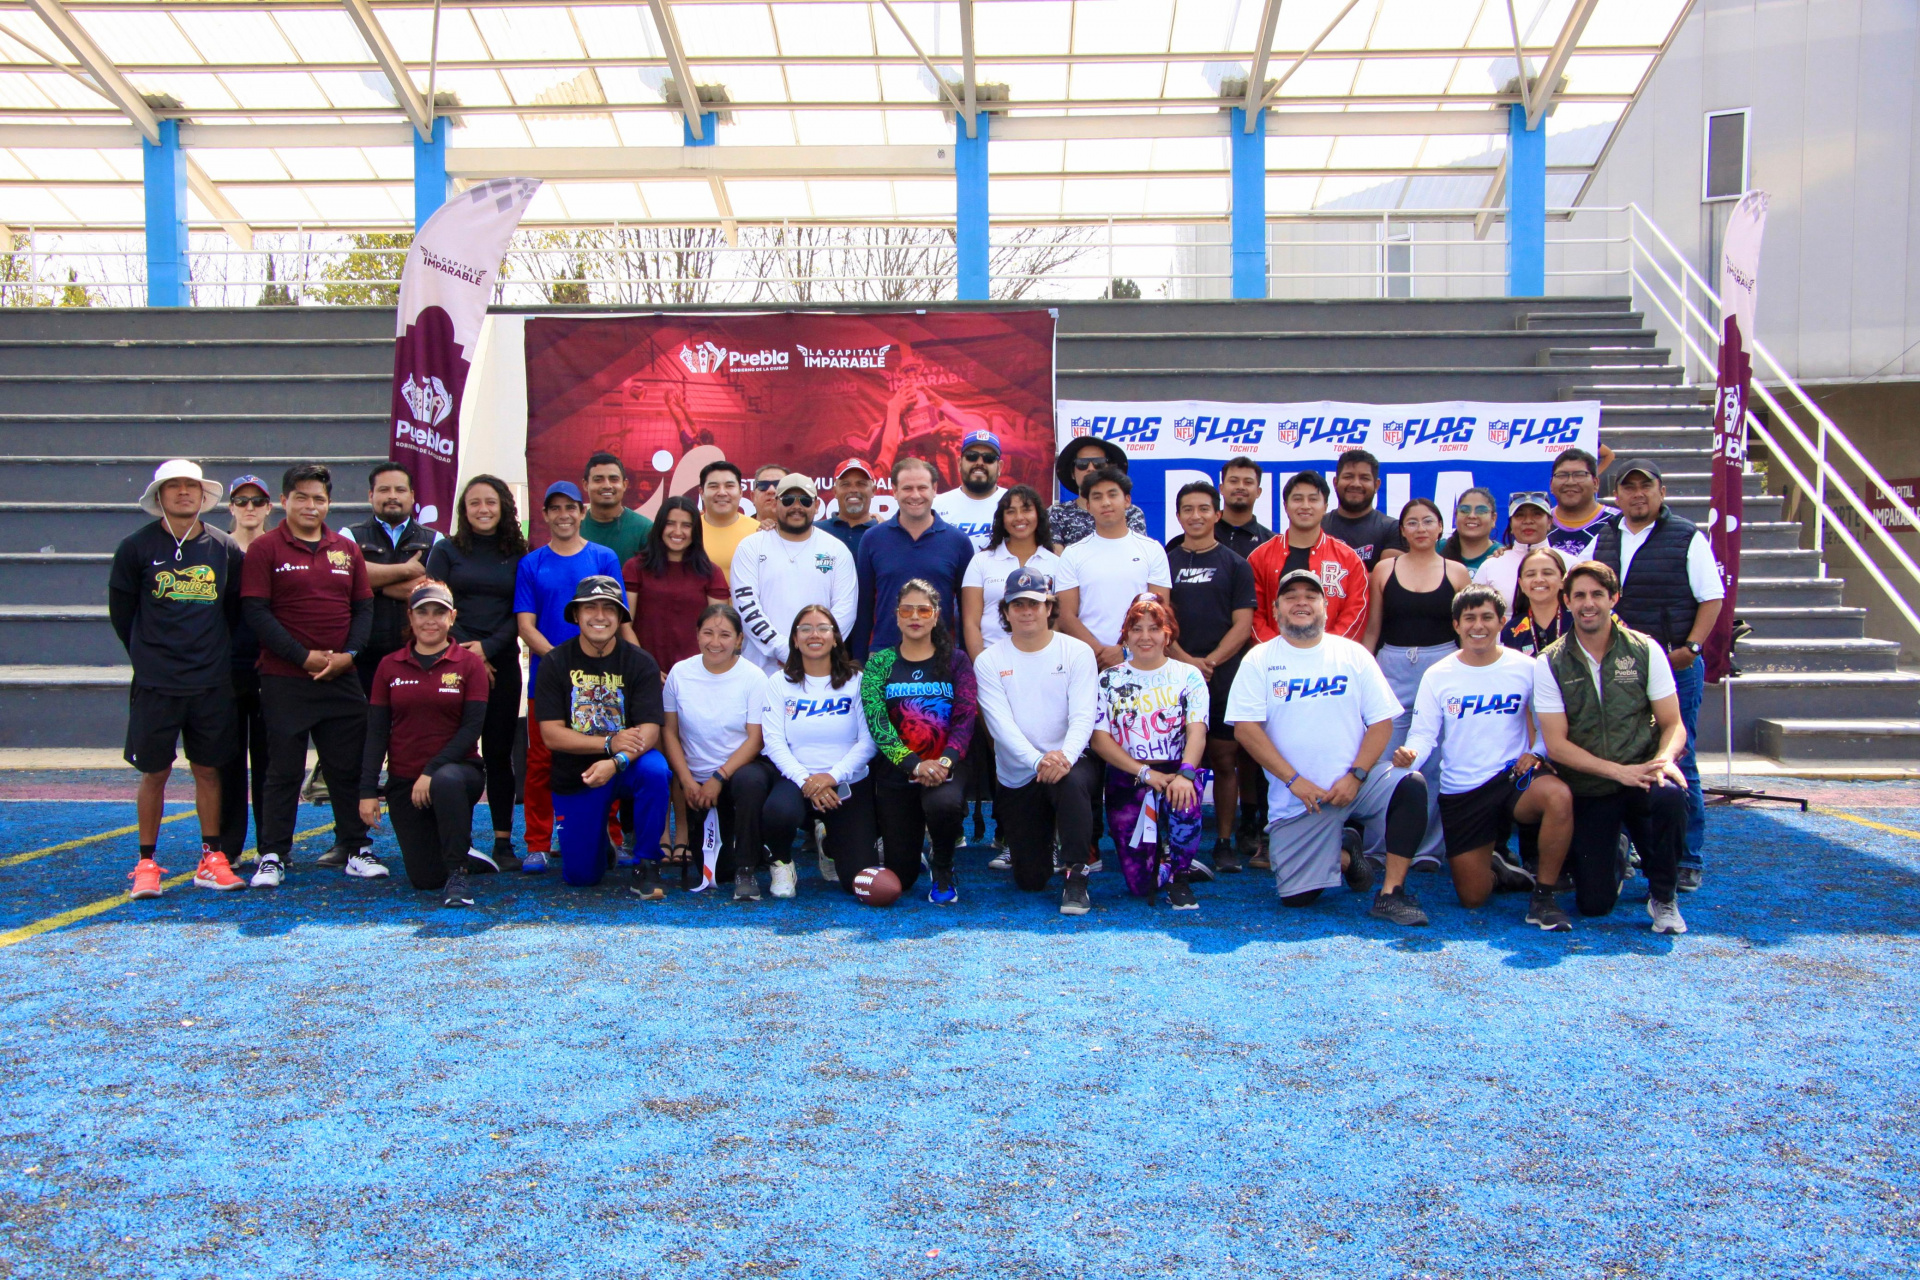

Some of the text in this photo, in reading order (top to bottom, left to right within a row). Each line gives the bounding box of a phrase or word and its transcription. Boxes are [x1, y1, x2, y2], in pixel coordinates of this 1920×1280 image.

[423, 257, 482, 286] IMPARABLE
[442, 257, 477, 275] CAPITAL
[729, 349, 789, 366] Puebla
[804, 357, 886, 368] IMPARABLE
[396, 419, 454, 455] Puebla
[1073, 416, 1162, 442] NFL FLAG
[1176, 416, 1266, 447] NFL FLAG
[1279, 417, 1371, 449] NFL FLAG
[1384, 417, 1477, 451] NFL FLAG
[1490, 416, 1584, 450] NFL FLAG
[1229, 445, 1259, 453] TOCHITO
[152, 571, 217, 599] Pericos
[1175, 568, 1217, 583] NIKE
[735, 586, 778, 645] COACH
[1274, 675, 1348, 702] NFL FLAG
[791, 697, 852, 720] FLAG
[1448, 694, 1521, 719] NFL FLAG
